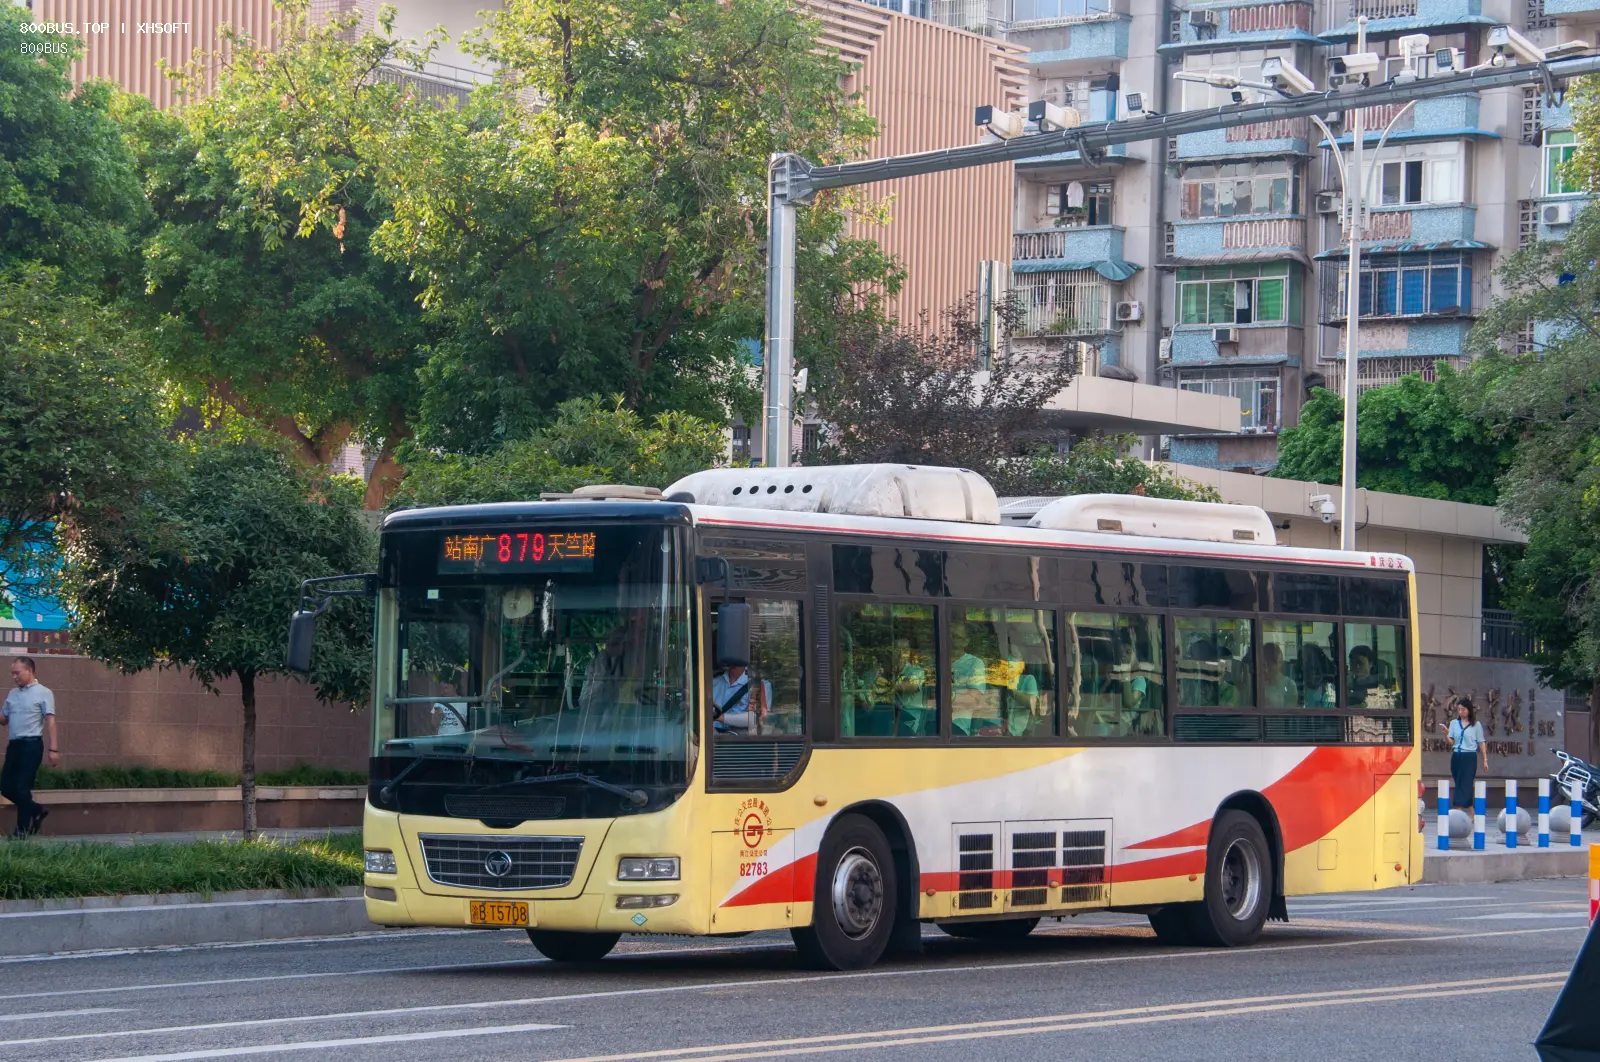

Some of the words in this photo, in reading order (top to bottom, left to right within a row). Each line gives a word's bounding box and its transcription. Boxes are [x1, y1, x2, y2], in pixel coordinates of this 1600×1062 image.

[445, 534, 496, 561] 站南广
[499, 533, 545, 562] 879
[548, 532, 597, 561] 天竺路
[740, 862, 768, 877] 82783
